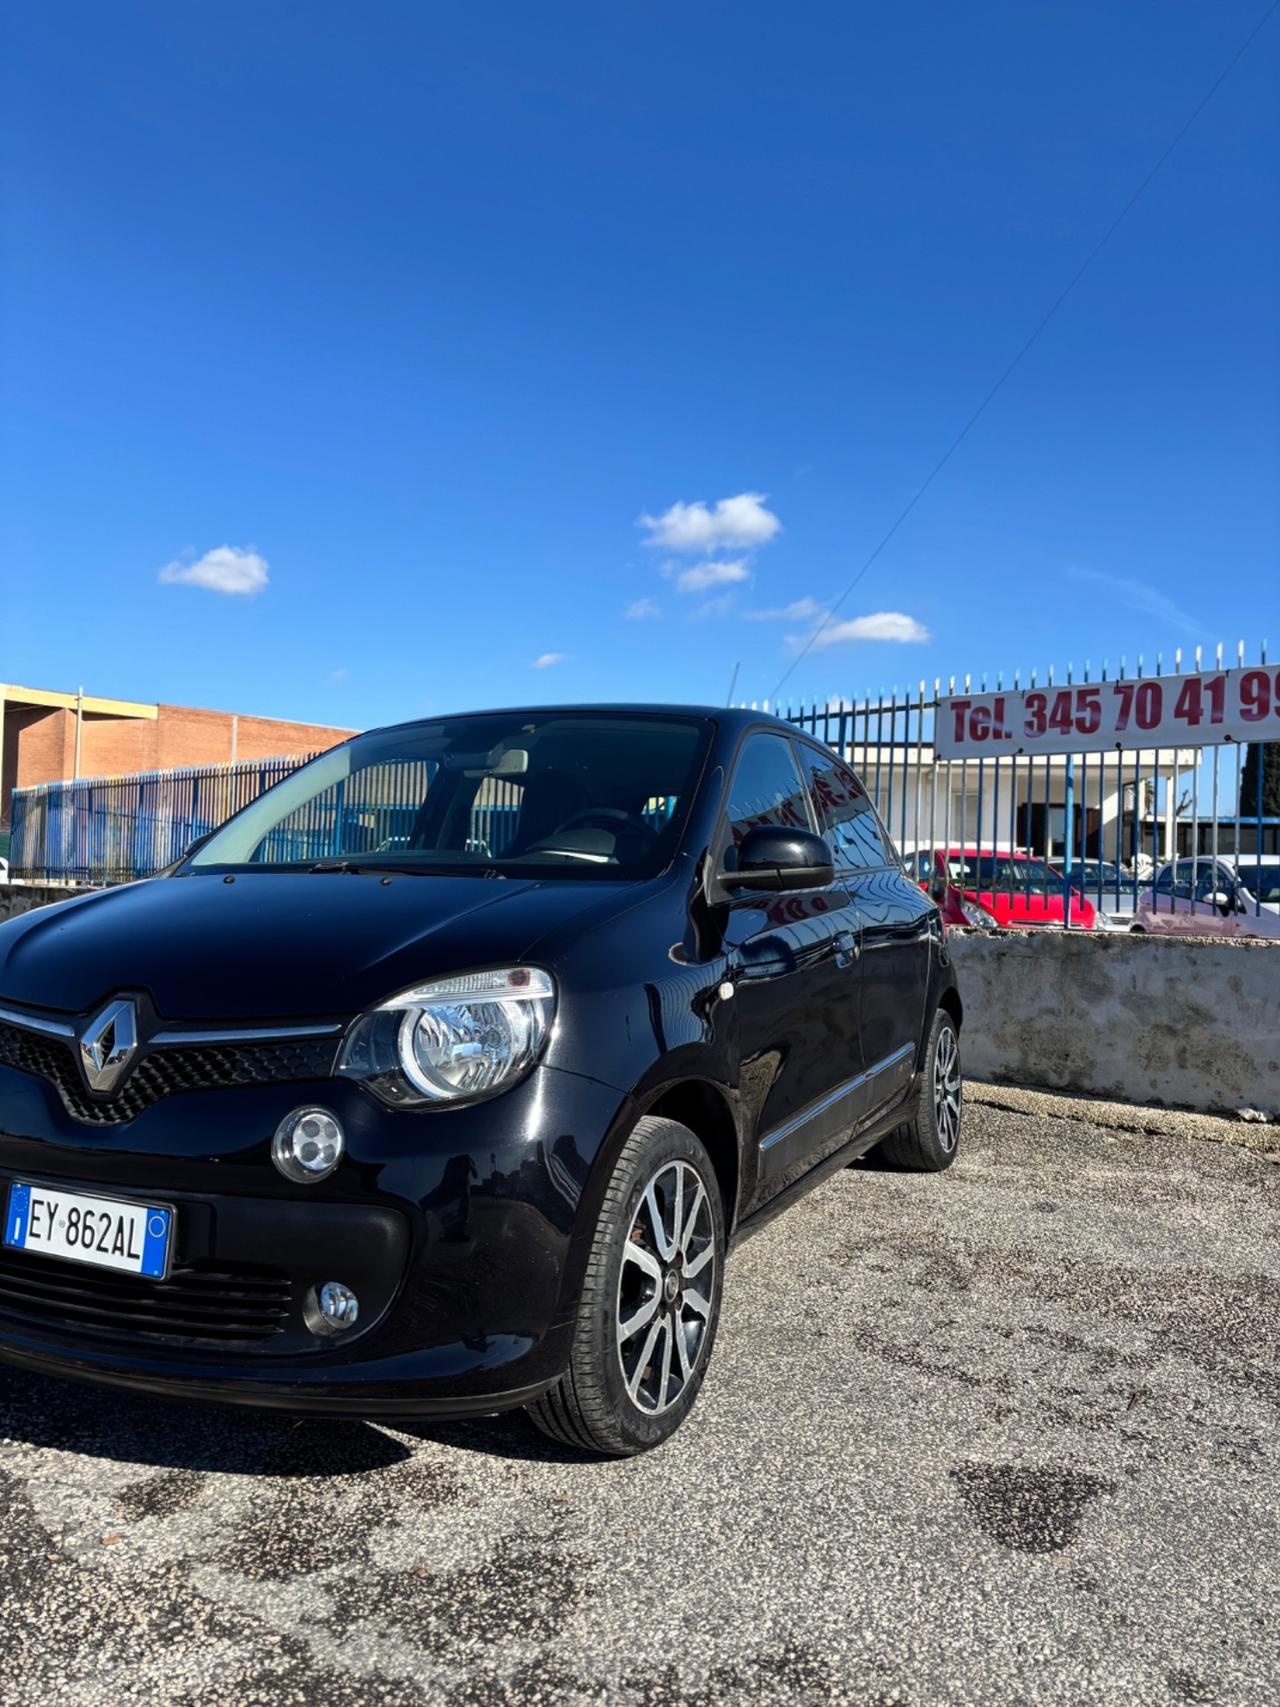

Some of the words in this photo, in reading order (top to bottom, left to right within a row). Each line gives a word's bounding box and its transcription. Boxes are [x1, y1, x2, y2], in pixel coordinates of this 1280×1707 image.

[950, 698, 1013, 742] Tel.
[1024, 688, 1101, 738] 345
[1114, 682, 1163, 731] 70
[1174, 676, 1226, 726] 41
[1239, 671, 1280, 722] 9
